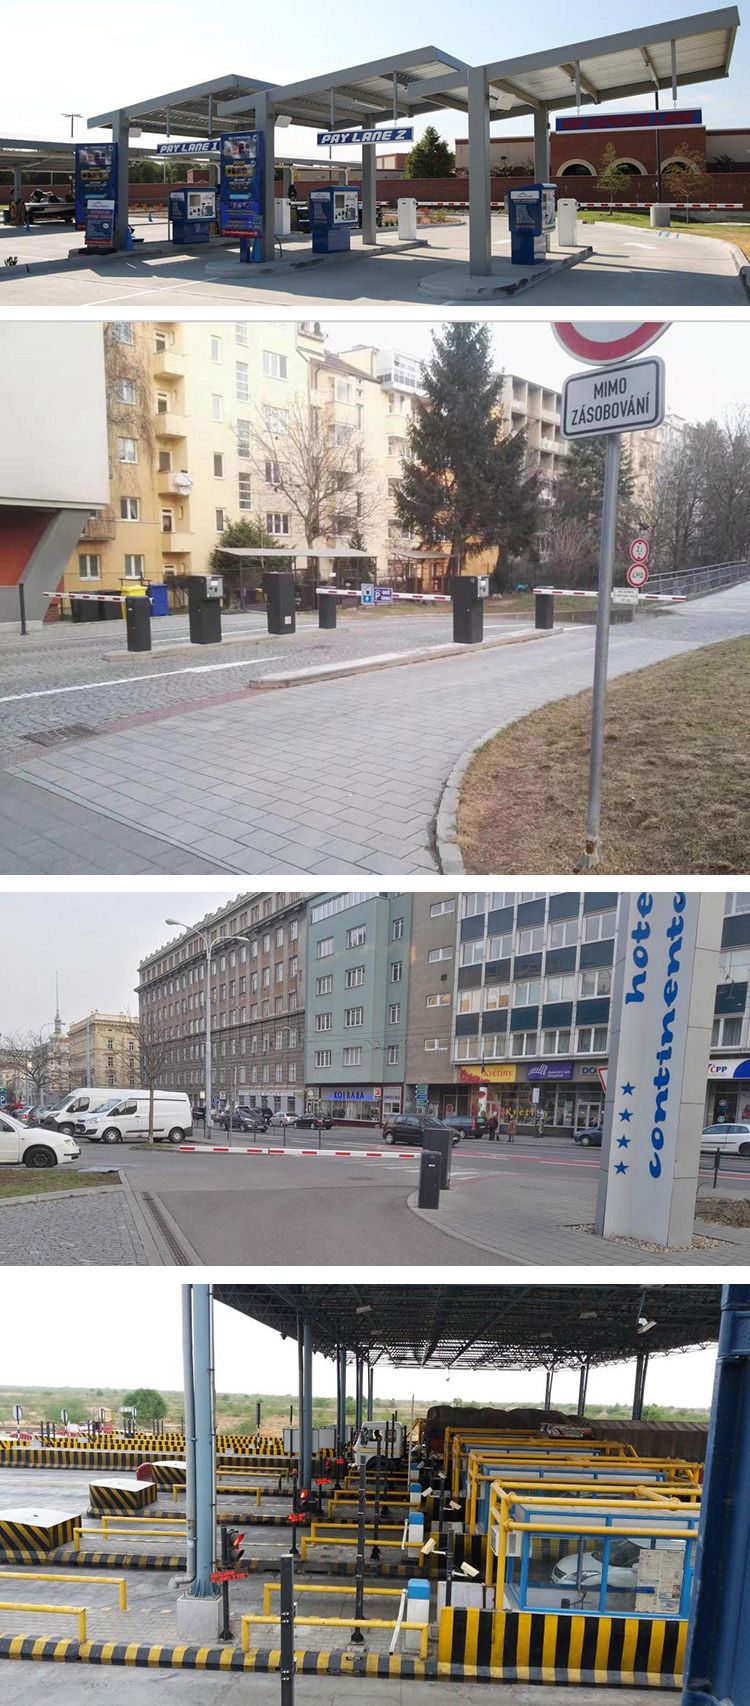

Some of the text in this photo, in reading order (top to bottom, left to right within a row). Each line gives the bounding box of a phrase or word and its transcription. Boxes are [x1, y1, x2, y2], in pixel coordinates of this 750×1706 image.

[160, 141, 218, 153] PAY LANE 1
[320, 130, 408, 144] PAY LANE 2
[593, 377, 627, 400] MIMO
[571, 391, 651, 426] ZÁSOBOVÁNÍ
[624, 893, 654, 1005] hote
[648, 893, 687, 1179] continenta
